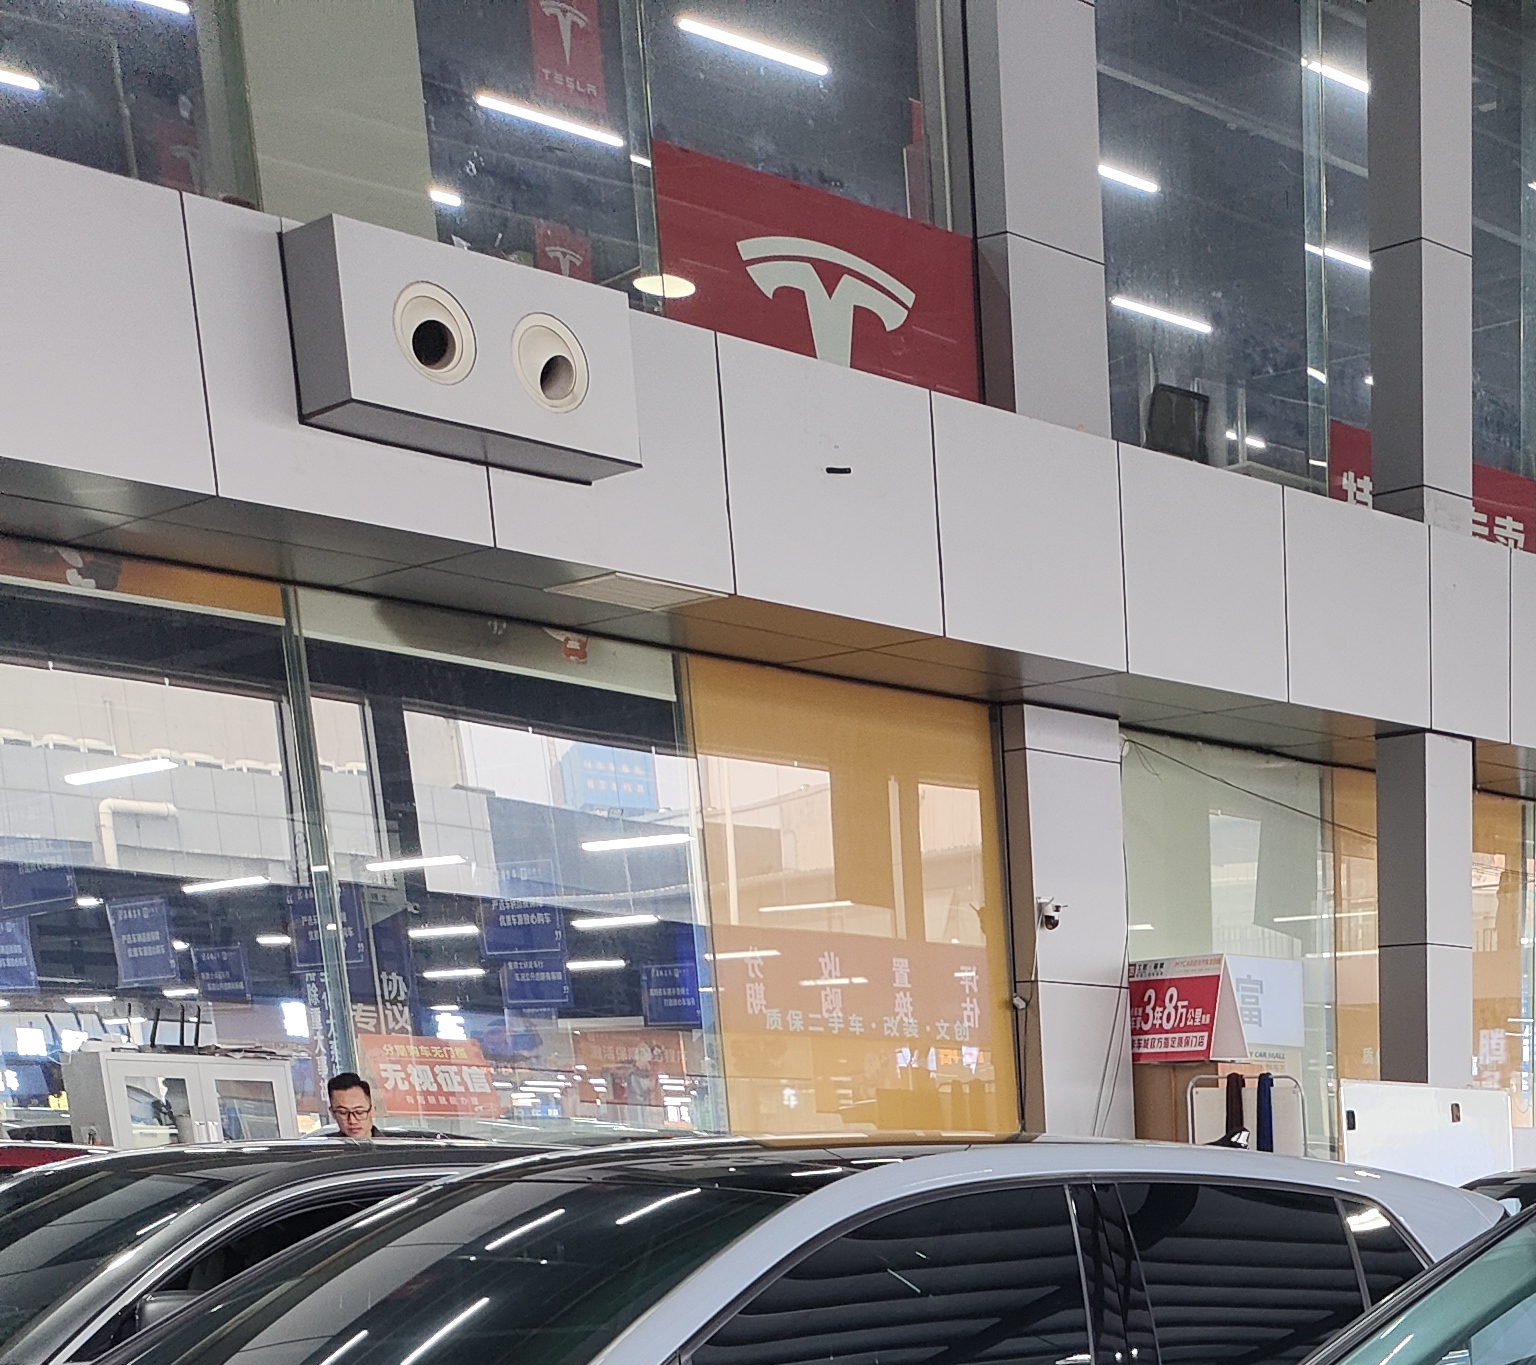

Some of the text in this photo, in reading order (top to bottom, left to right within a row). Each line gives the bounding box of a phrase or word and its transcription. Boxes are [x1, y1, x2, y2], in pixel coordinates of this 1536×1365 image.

[541, 68, 597, 96] TESLA
[1235, 975, 1263, 1028] 富
[379, 1062, 492, 1094] 无视征信
